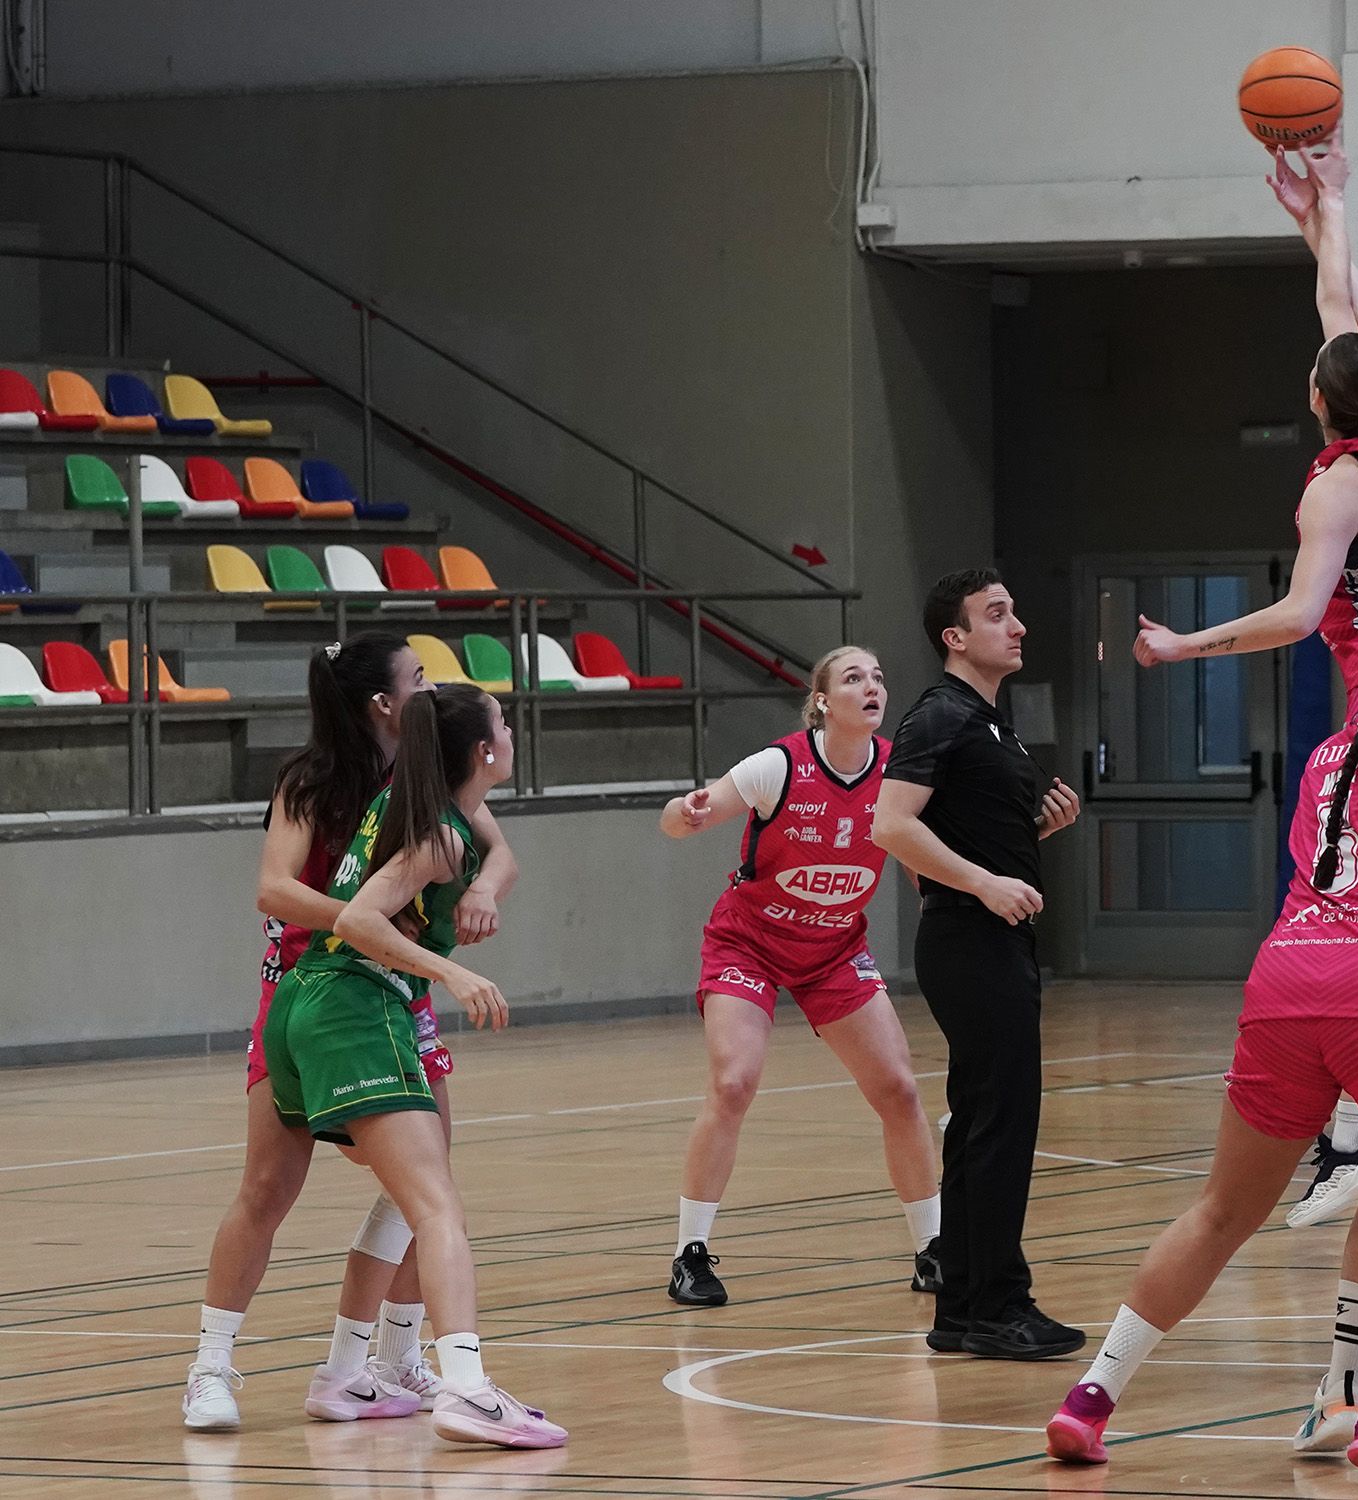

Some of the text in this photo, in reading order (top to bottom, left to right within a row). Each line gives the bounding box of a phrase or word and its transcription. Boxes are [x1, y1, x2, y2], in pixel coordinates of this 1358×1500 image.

[1256, 122, 1324, 140] Wilson
[787, 801, 828, 816] enjoy!
[832, 816, 854, 848] 2
[785, 869, 865, 896] ABRIL
[1294, 937, 1344, 946] Internacional
[332, 1083, 354, 1097] Diario
